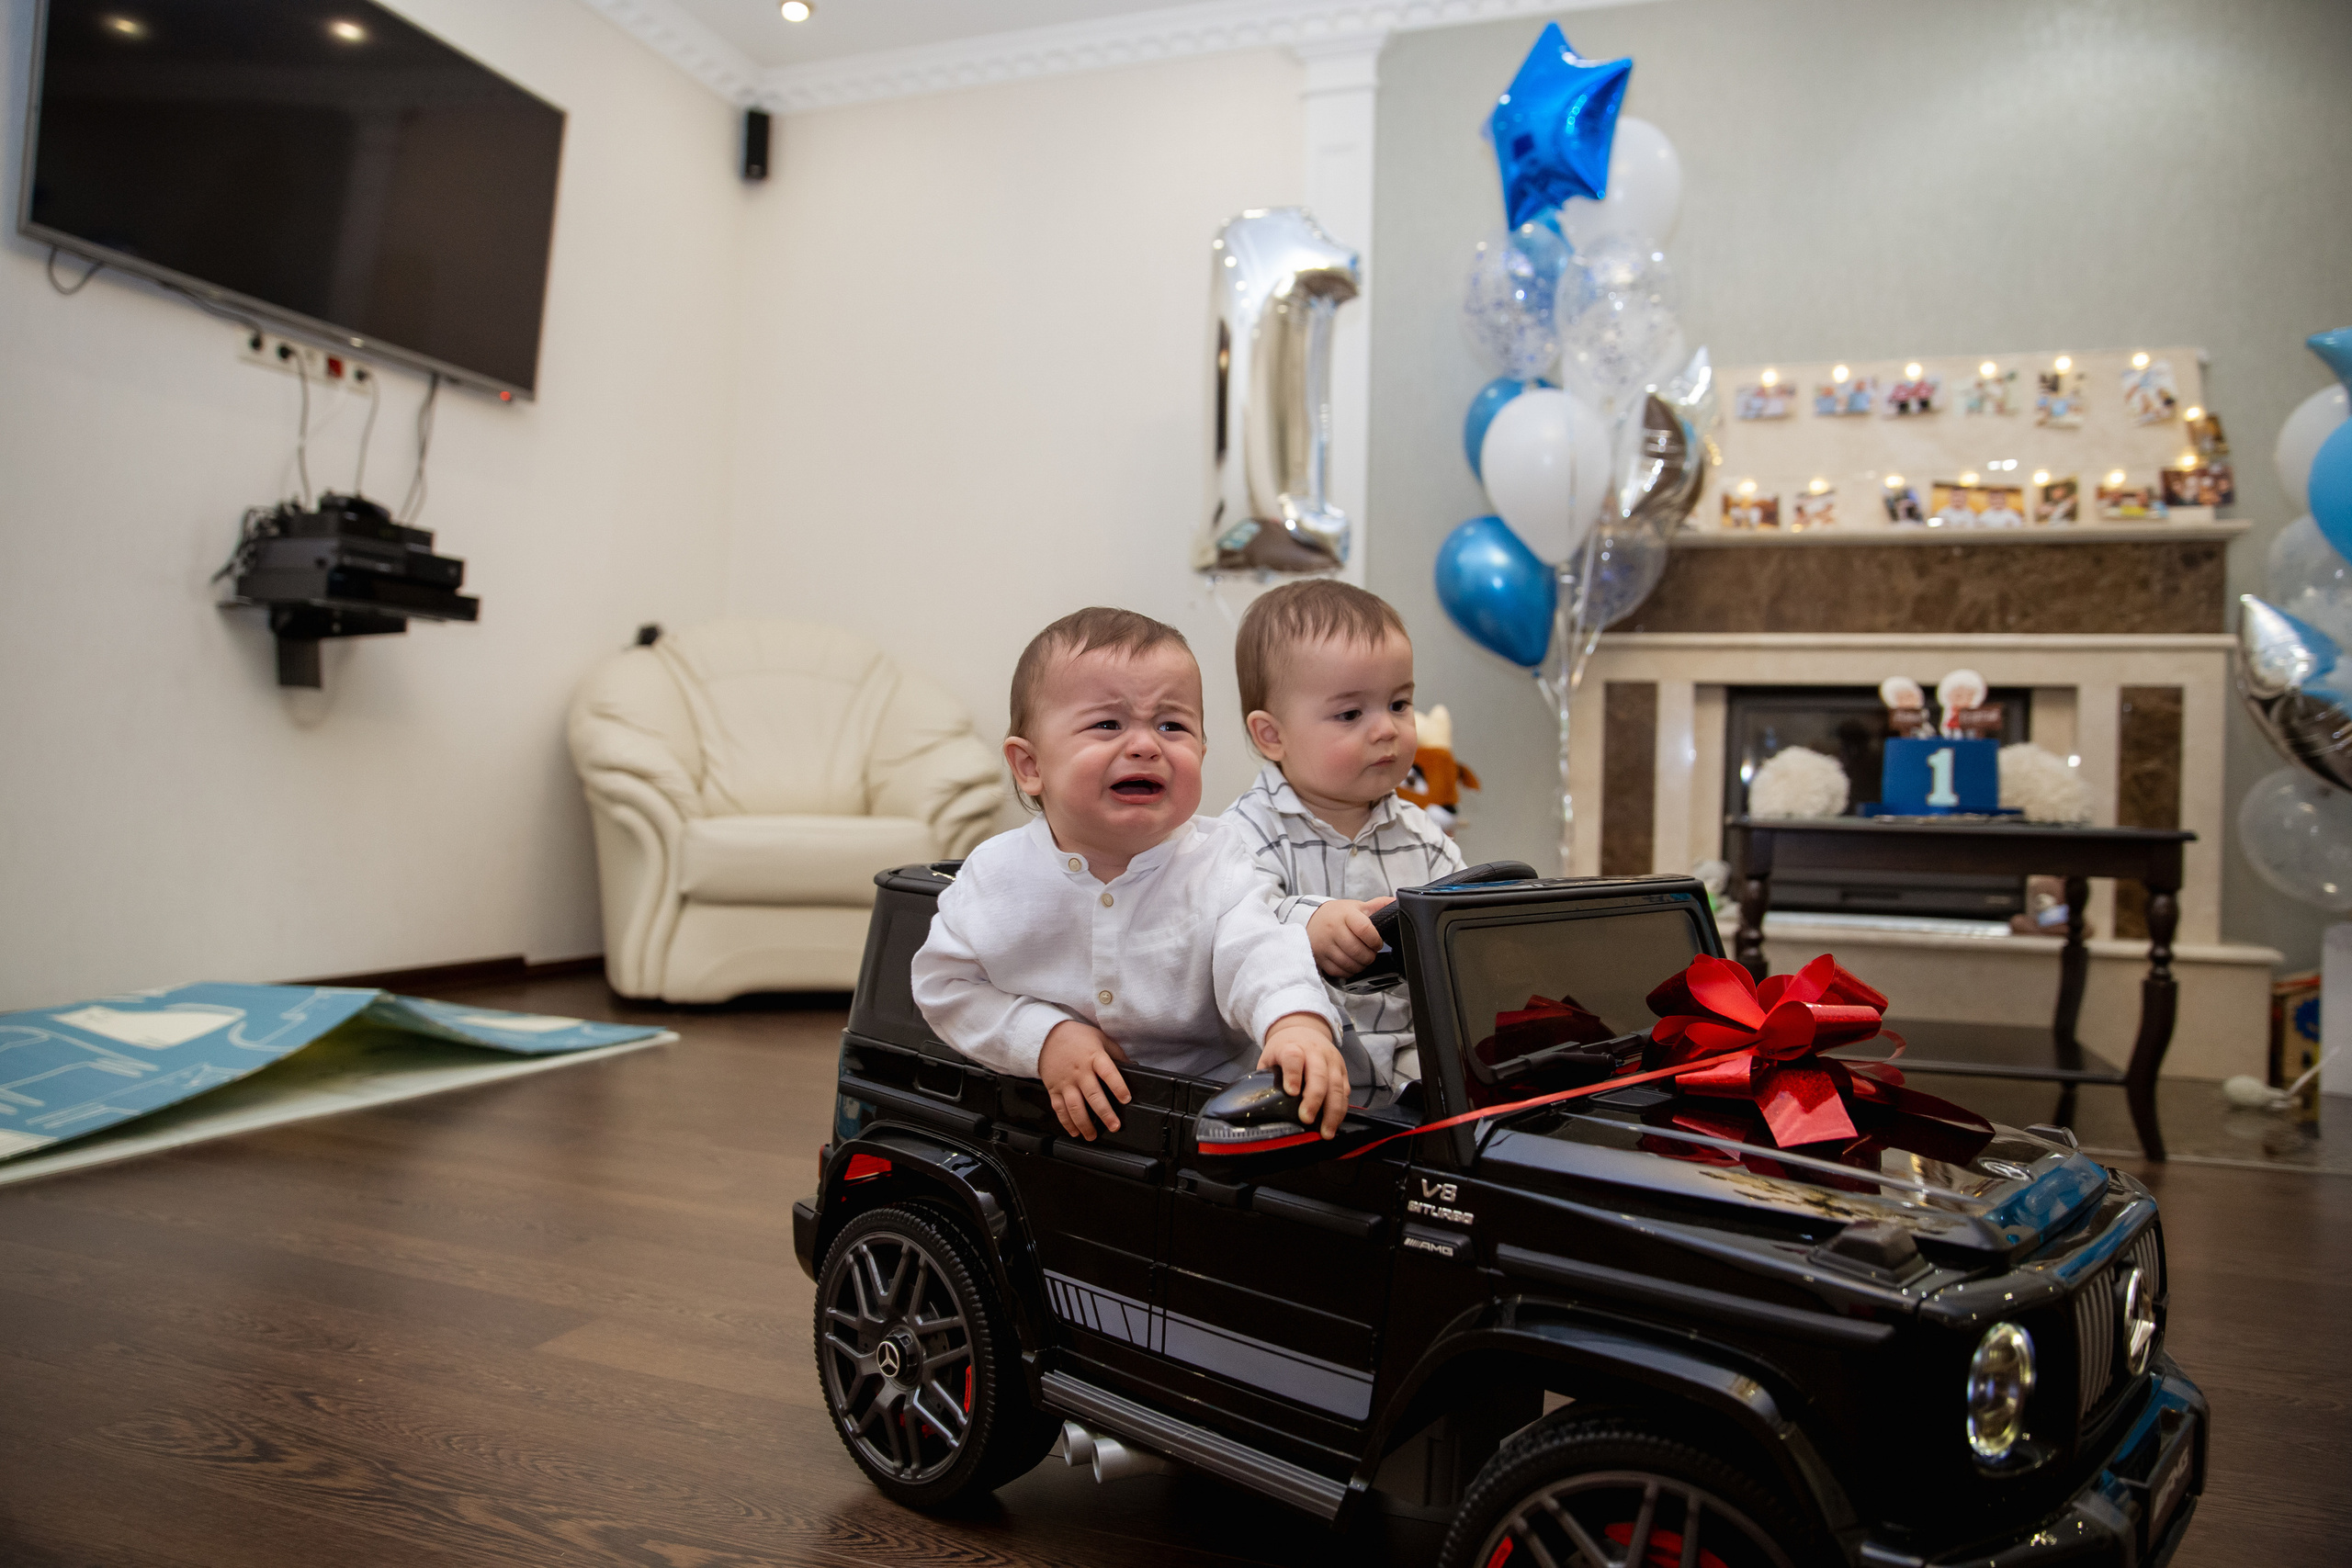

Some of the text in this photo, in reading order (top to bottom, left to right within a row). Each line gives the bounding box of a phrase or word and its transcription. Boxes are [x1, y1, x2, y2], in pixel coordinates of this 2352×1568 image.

[1926, 747, 1959, 807] 1
[1421, 1179, 1458, 1202] V8
[1408, 1200, 1475, 1225] BITURBO
[1418, 1241, 1454, 1258] AMG
